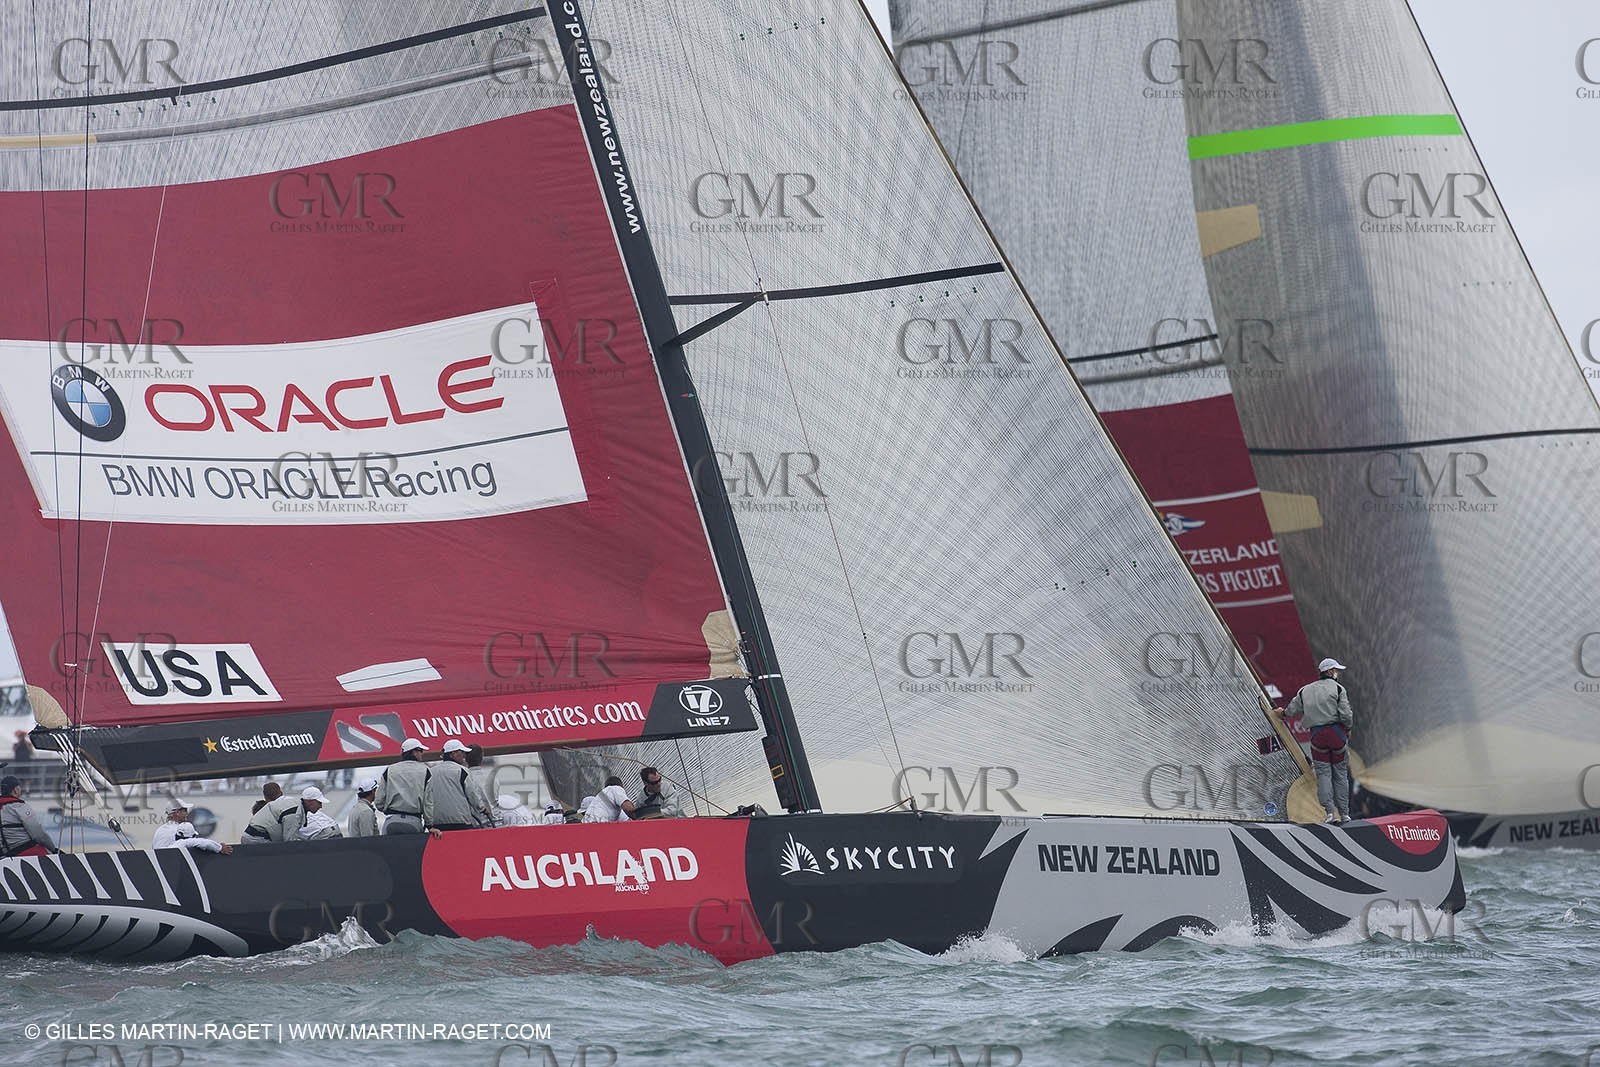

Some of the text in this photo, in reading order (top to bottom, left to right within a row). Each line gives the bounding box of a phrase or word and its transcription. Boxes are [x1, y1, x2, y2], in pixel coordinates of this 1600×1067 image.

[144, 355, 505, 432] ORACLE
[101, 460, 498, 500] BMW ORACLE Racing
[1220, 564, 1282, 592] PIGUET
[113, 649, 269, 698] USA
[412, 700, 647, 738] www.emirates.com
[1387, 824, 1441, 842] Fly Emirates
[1509, 821, 1553, 843] NEW
[481, 847, 699, 892] AUCKLAND
[825, 846, 956, 871] SKYCITY
[1037, 844, 1221, 877] NEW ZEALAND
